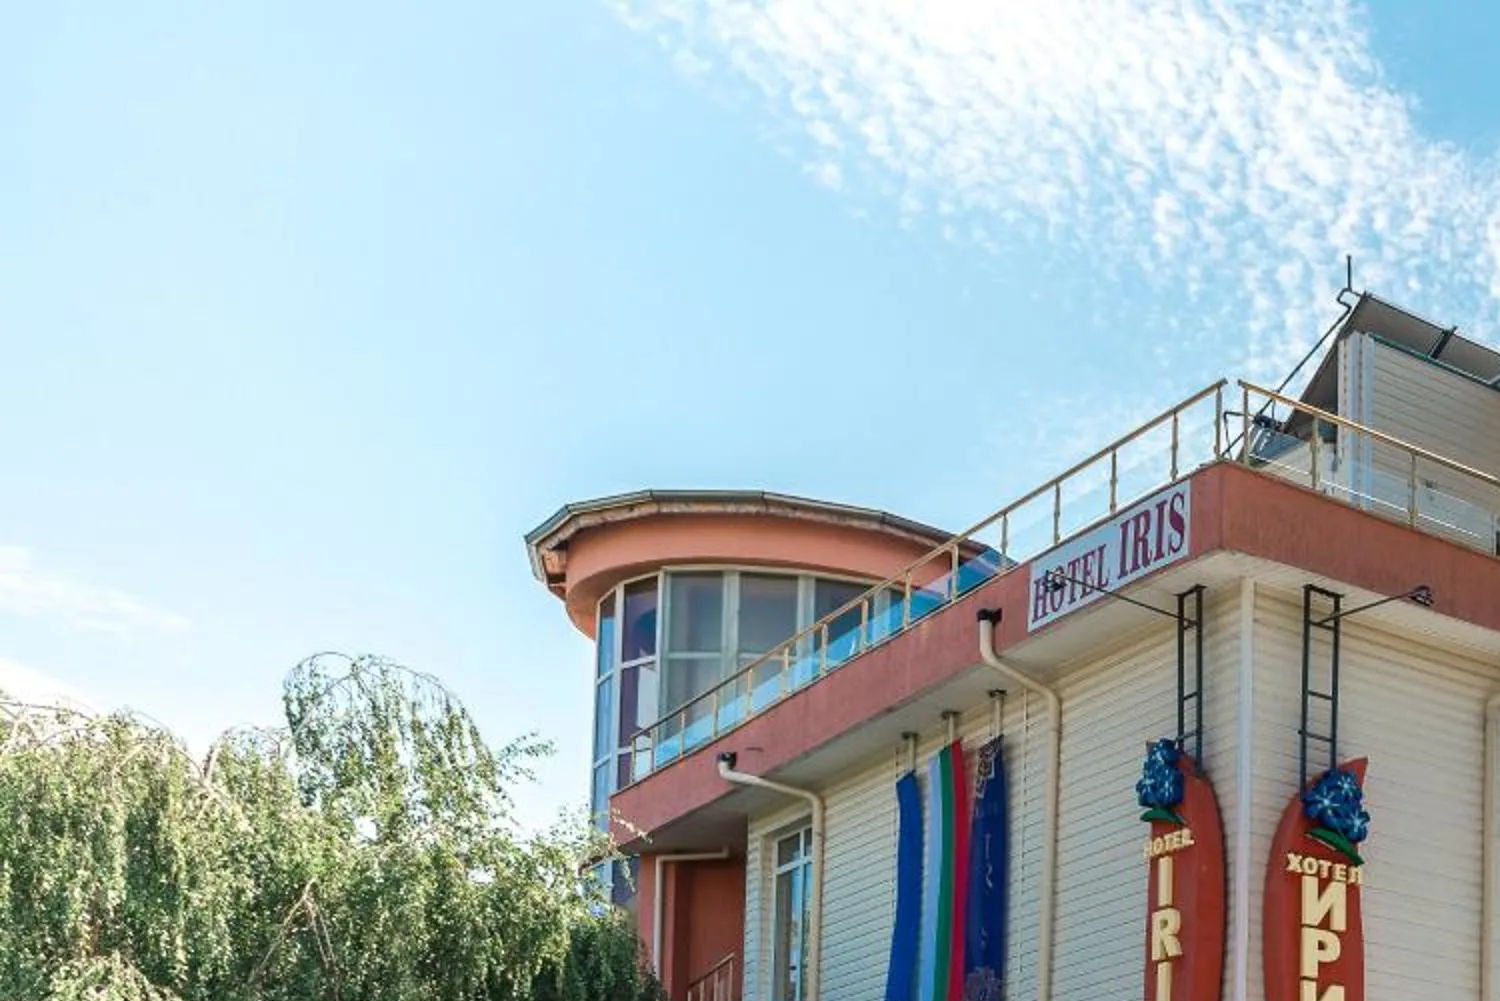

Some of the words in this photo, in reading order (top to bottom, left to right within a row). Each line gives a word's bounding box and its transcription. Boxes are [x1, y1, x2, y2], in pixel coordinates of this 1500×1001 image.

[1032, 544, 1110, 623] HOTEL
[1118, 492, 1186, 580] IRIS
[1143, 828, 1195, 858] HOTEL
[1286, 853, 1363, 885] ХОТЕЛ
